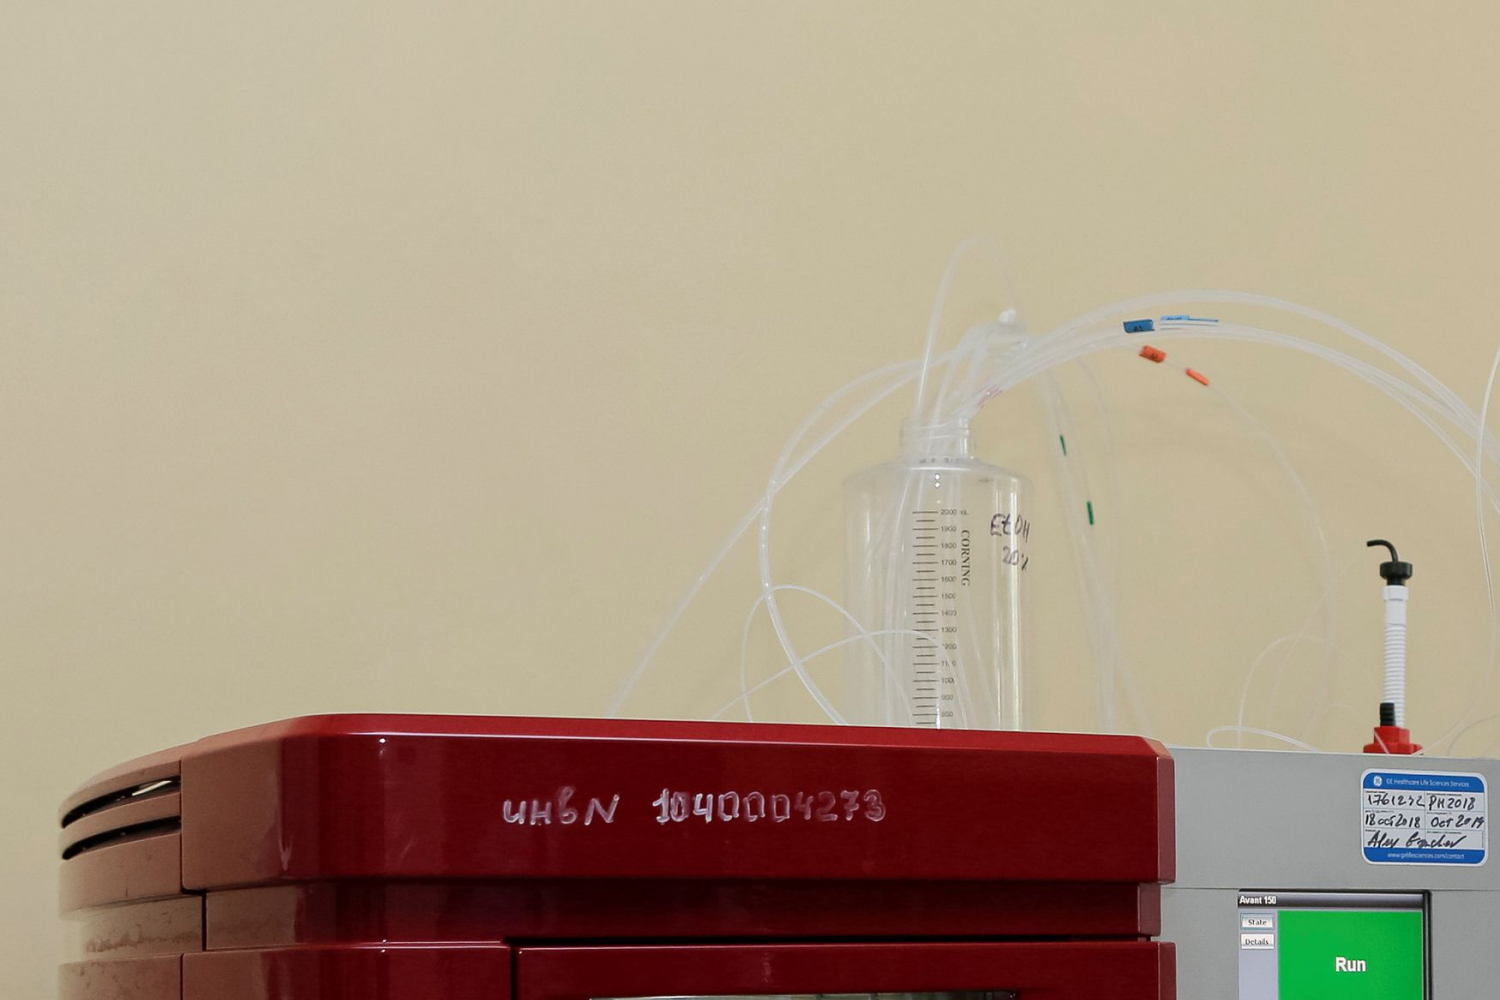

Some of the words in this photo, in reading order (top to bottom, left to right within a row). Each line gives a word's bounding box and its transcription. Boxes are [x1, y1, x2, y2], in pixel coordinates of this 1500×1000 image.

[990, 513, 1030, 542] EtOH
[961, 529, 971, 587] CORNING
[1239, 895, 1262, 905] Avant
[1263, 896, 1277, 905] 150
[1245, 938, 1269, 946] Details
[1335, 957, 1366, 972] Run
